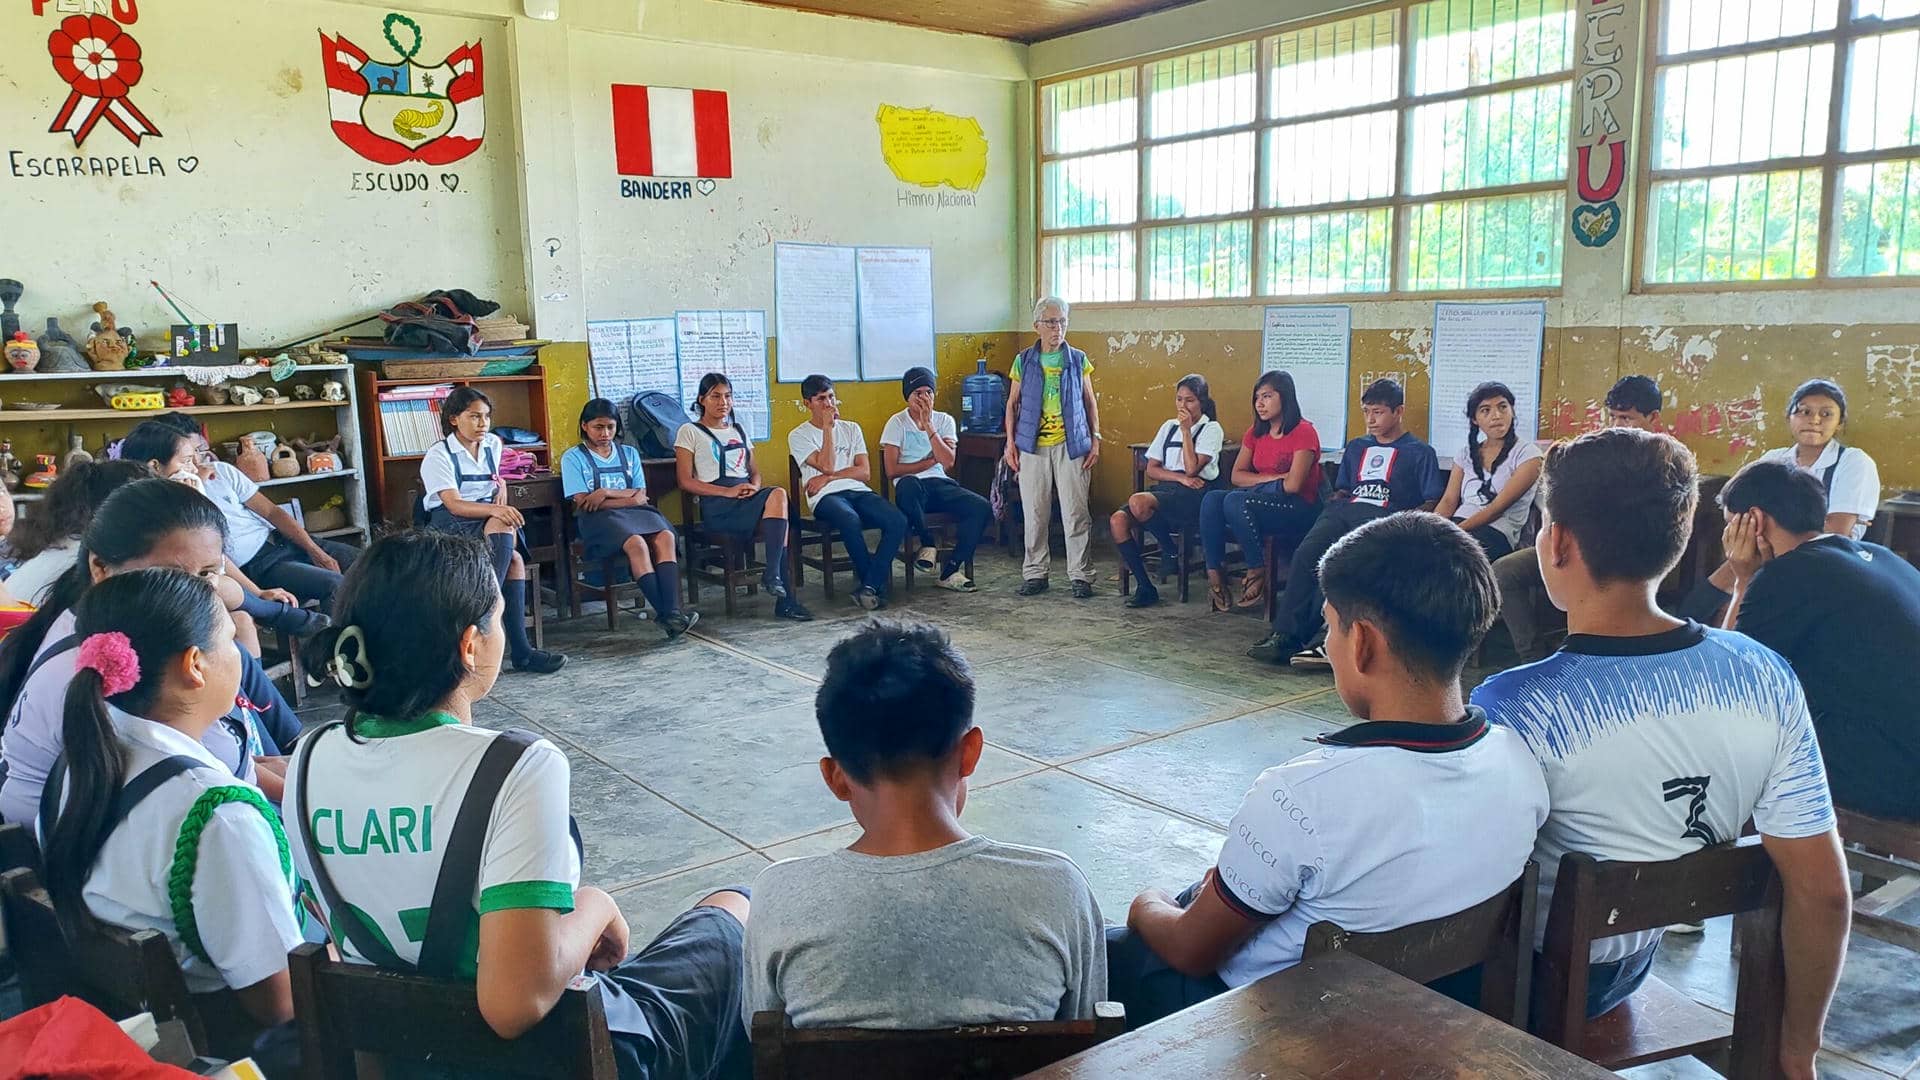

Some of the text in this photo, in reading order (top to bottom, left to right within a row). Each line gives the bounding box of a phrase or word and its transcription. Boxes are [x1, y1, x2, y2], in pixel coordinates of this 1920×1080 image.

[1576, 0, 1627, 203] ERÚ
[9, 150, 166, 177] ESCARAPELA
[351, 172, 429, 192] ESCUDO
[621, 179, 692, 200] BANDERA
[897, 189, 935, 207] Himno
[311, 805, 433, 855] CLARI
[1272, 789, 1315, 835] GUCCI
[1238, 824, 1278, 868] GUCCI
[1225, 866, 1263, 902] GUCCI
